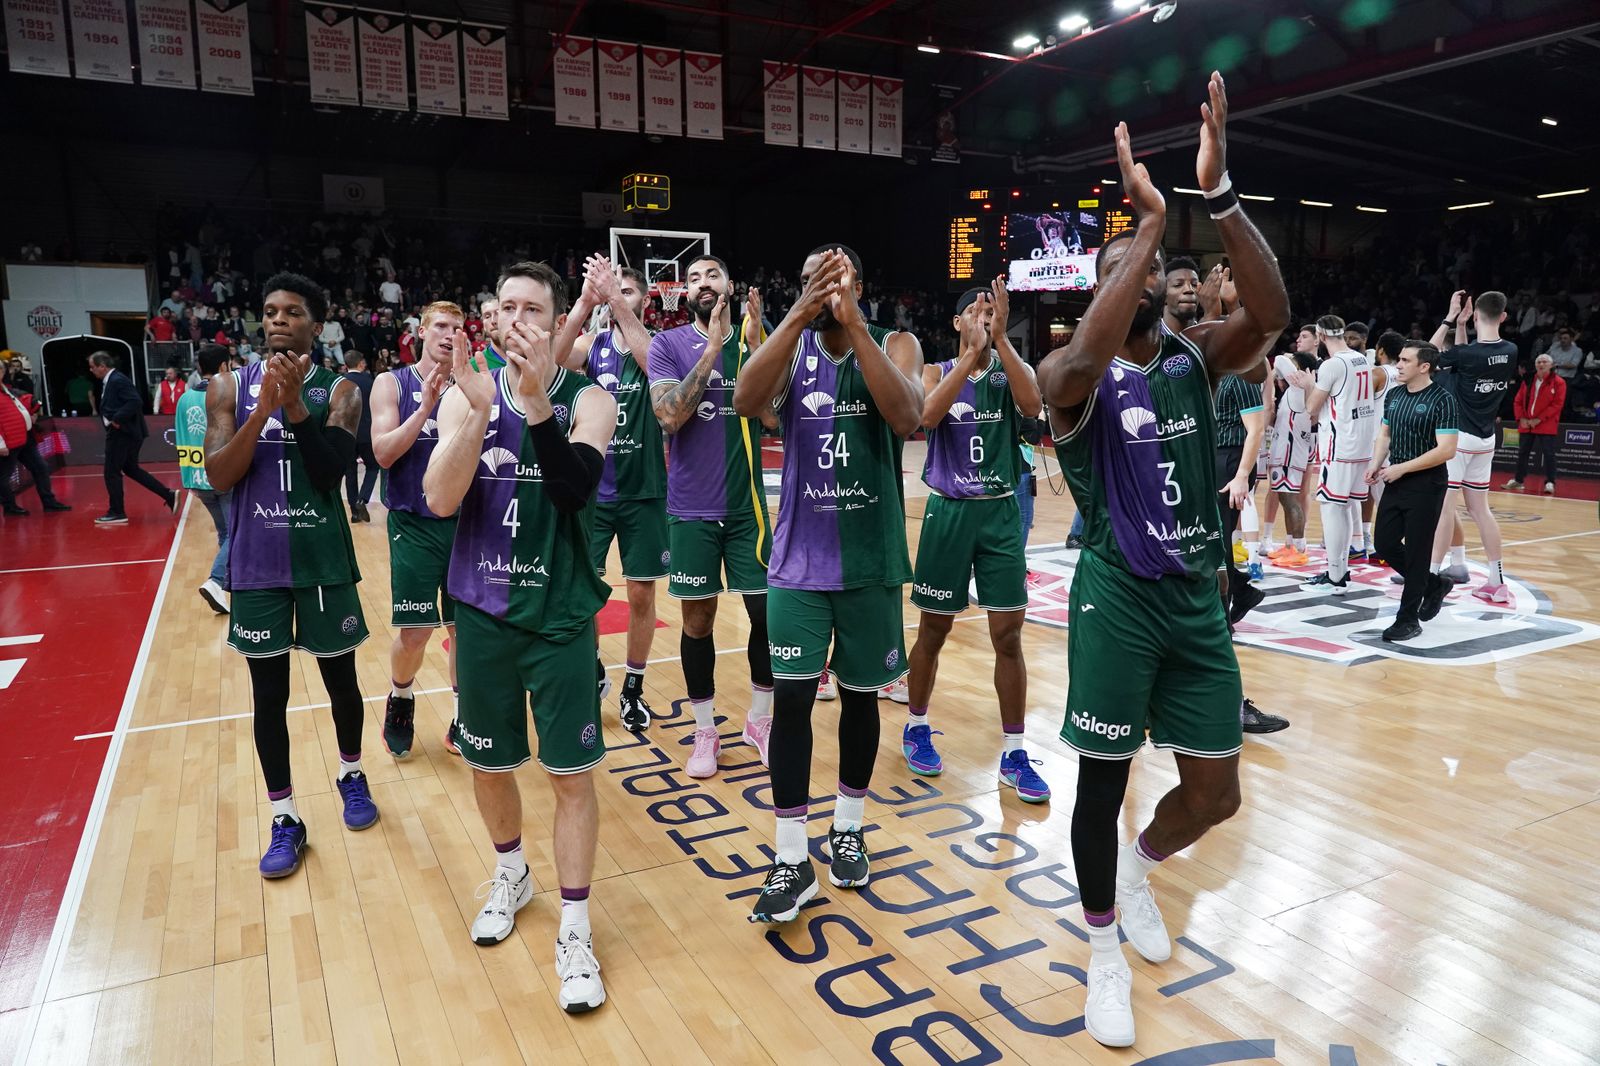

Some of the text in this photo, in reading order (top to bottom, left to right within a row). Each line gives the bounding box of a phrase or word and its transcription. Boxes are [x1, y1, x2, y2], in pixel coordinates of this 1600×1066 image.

[17, 18, 53, 30] 1991
[18, 29, 55, 42] 1992
[84, 32, 119, 45] 1994
[206, 27, 241, 37] CADETS
[149, 33, 182, 45] 1994
[209, 47, 241, 59] 2008
[693, 101, 716, 110] 2008
[809, 113, 829, 122] 2010
[844, 118, 864, 126] 2010
[771, 122, 792, 131] 2023
[878, 121, 896, 129] 2011
[27, 314, 63, 328] CHOLET
[1356, 371, 1368, 401] 77
[973, 408, 1004, 421] Unicaj
[1155, 413, 1197, 437] Unicaja
[818, 432, 850, 470] 34
[969, 435, 984, 464] 6
[277, 459, 293, 491] 11
[515, 463, 542, 477] Unic
[803, 480, 870, 499] Andalucía
[1157, 461, 1182, 507] 3
[253, 502, 319, 519] Andalucía
[502, 498, 521, 538] 4
[1145, 515, 1207, 541] Adalucía
